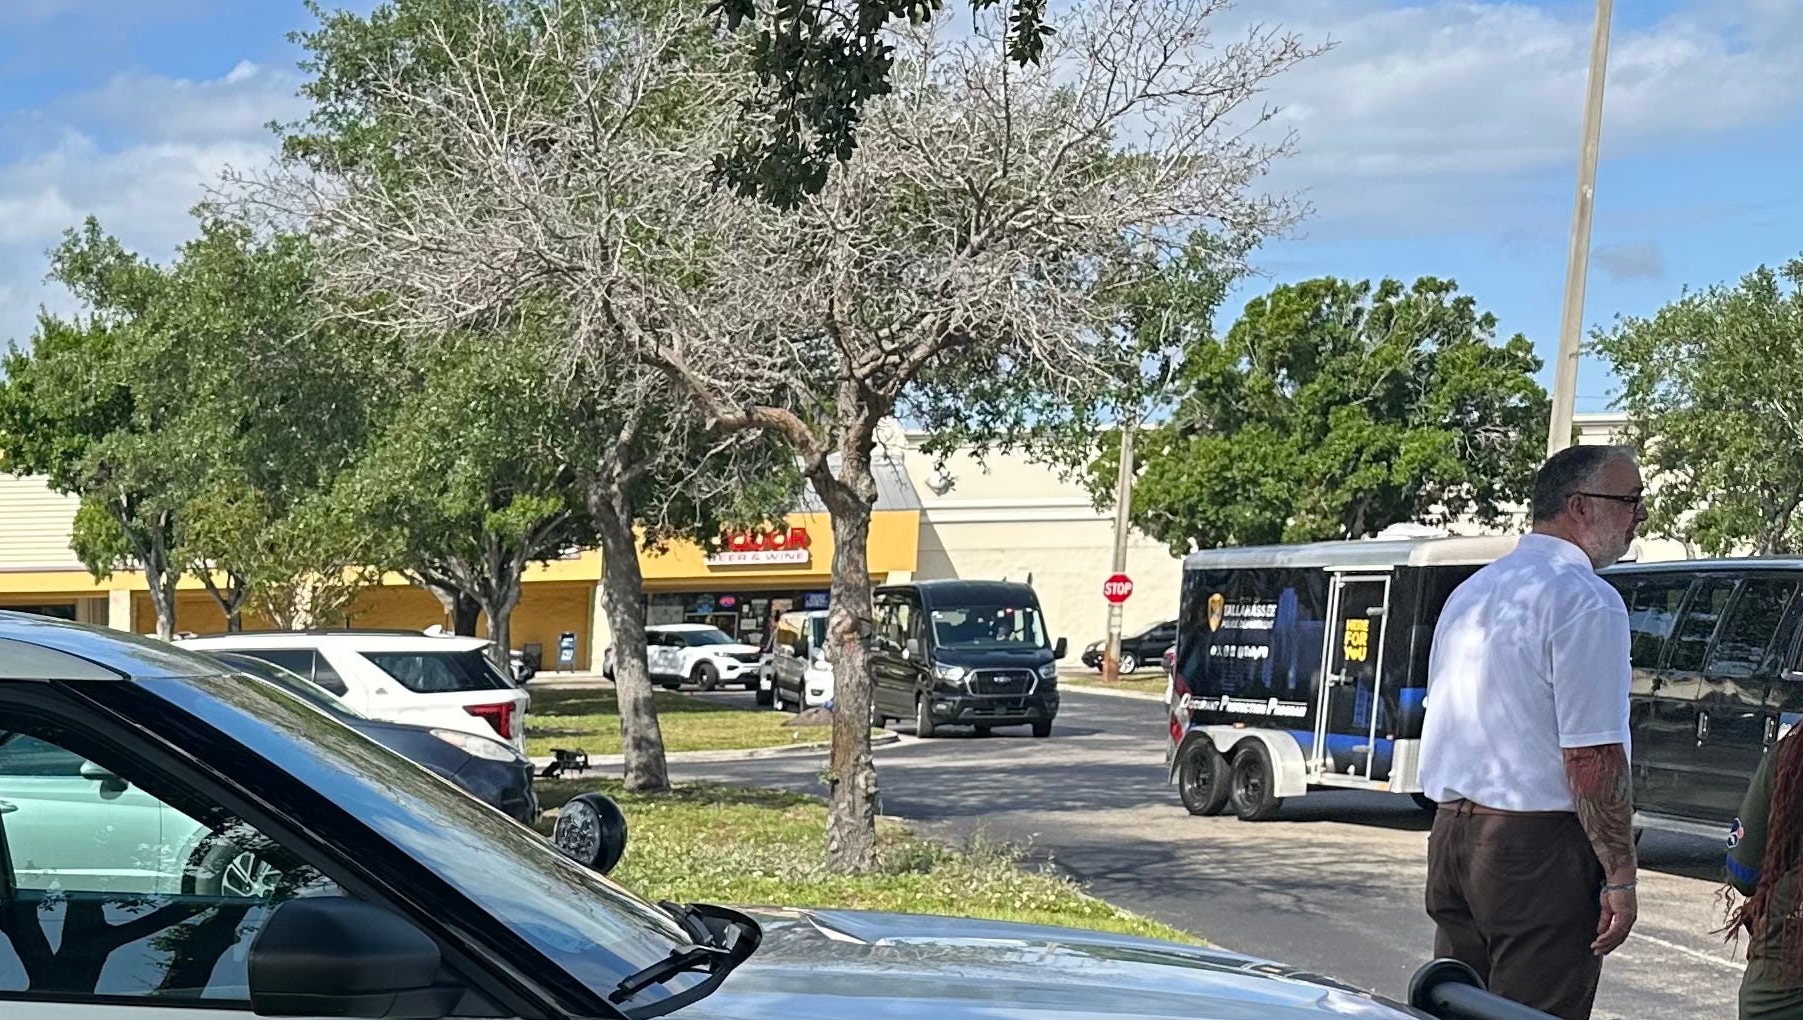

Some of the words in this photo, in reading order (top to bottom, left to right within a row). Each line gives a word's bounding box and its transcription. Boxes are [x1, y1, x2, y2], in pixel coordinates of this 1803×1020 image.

[765, 551, 804, 561] WINE
[1104, 581, 1132, 596] STOP
[1344, 630, 1368, 647] FOR
